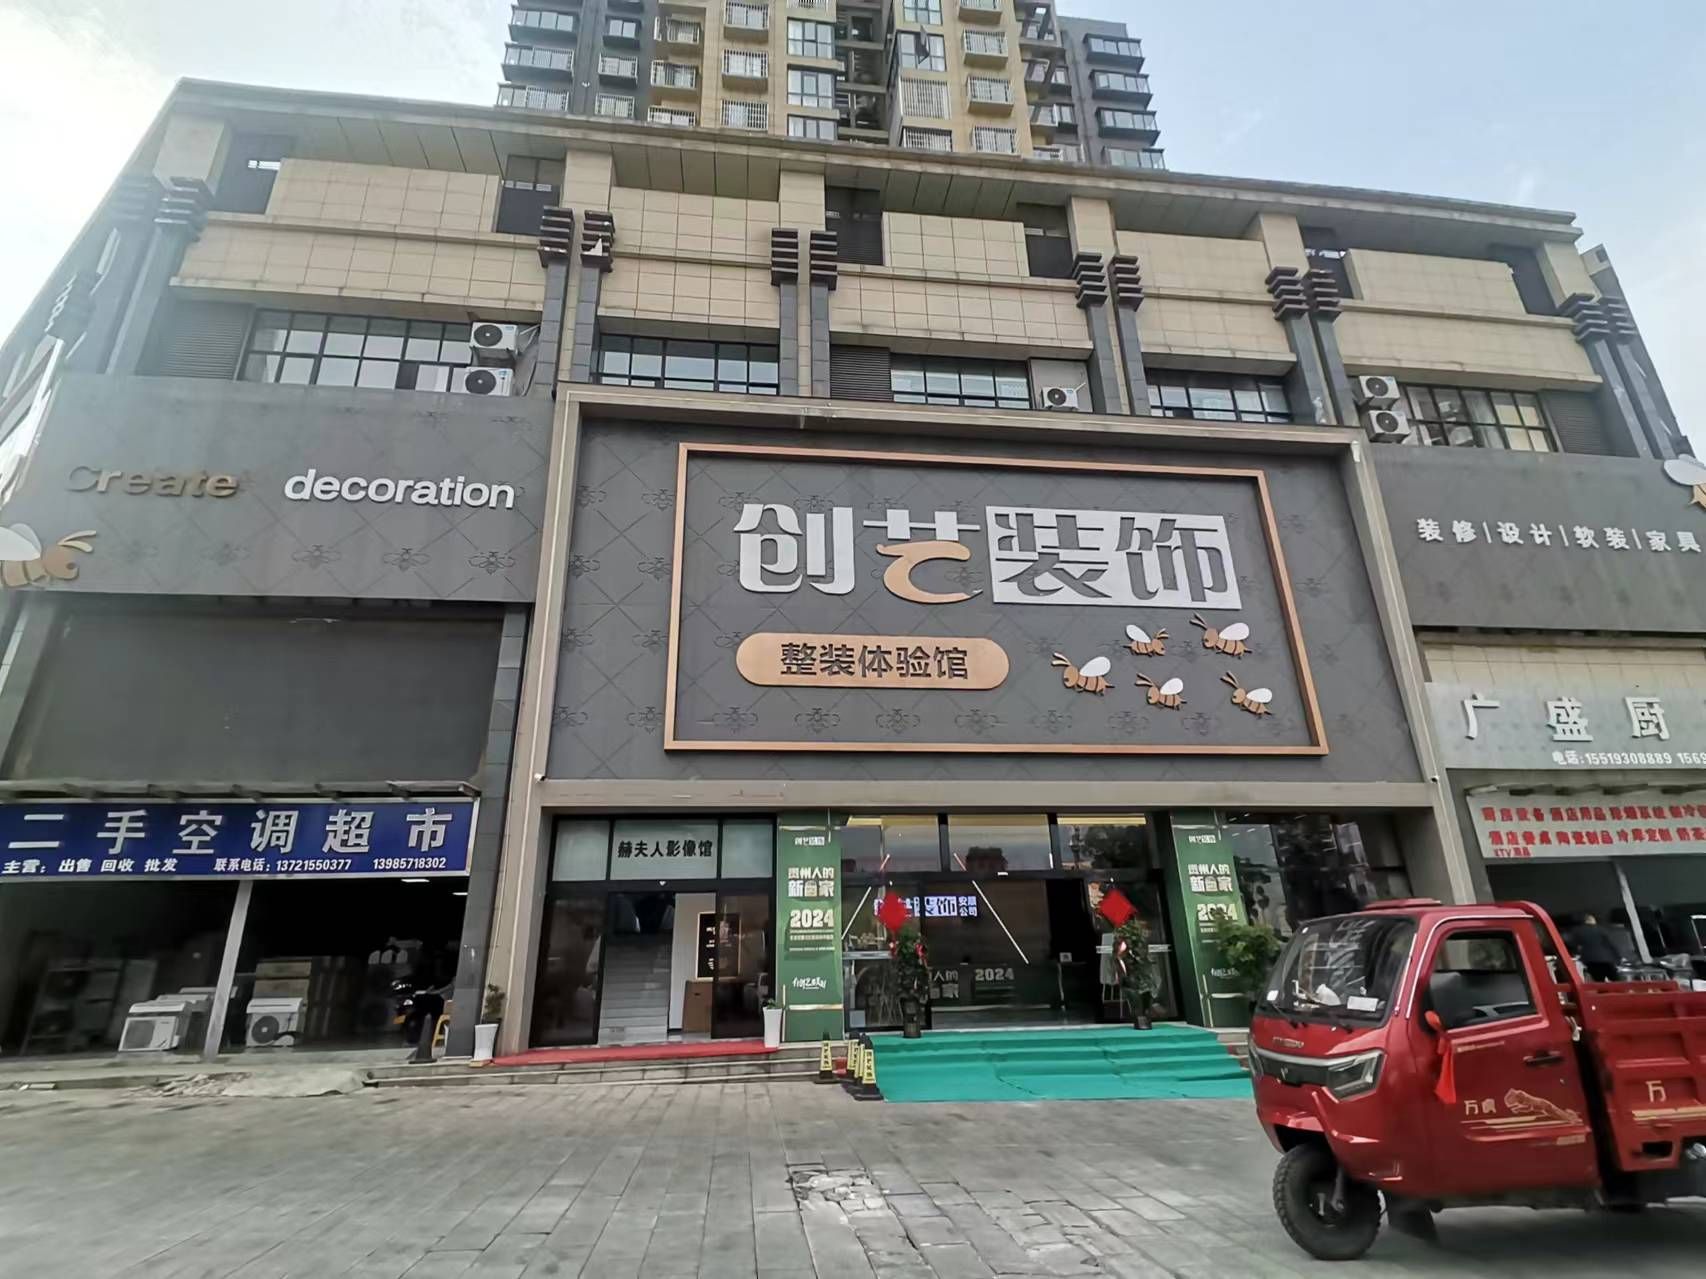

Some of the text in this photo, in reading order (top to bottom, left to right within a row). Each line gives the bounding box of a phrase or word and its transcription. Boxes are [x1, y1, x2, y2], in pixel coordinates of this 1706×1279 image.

[67, 465, 516, 508] Create decoration
[733, 503, 1242, 610] 创艺装饰
[780, 642, 969, 680] 整装体验馆
[8, 807, 454, 855] 二手空调超市
[617, 840, 713, 858] 赫夫人影像馆
[58, 858, 92, 873] 出售
[101, 858, 135, 872] 回收
[144, 858, 178, 872] 批发
[373, 857, 447, 870] 13985718302
[790, 908, 834, 928] 2024
[974, 968, 1015, 981] 2024
[1645, 1080, 1667, 1103] 万
